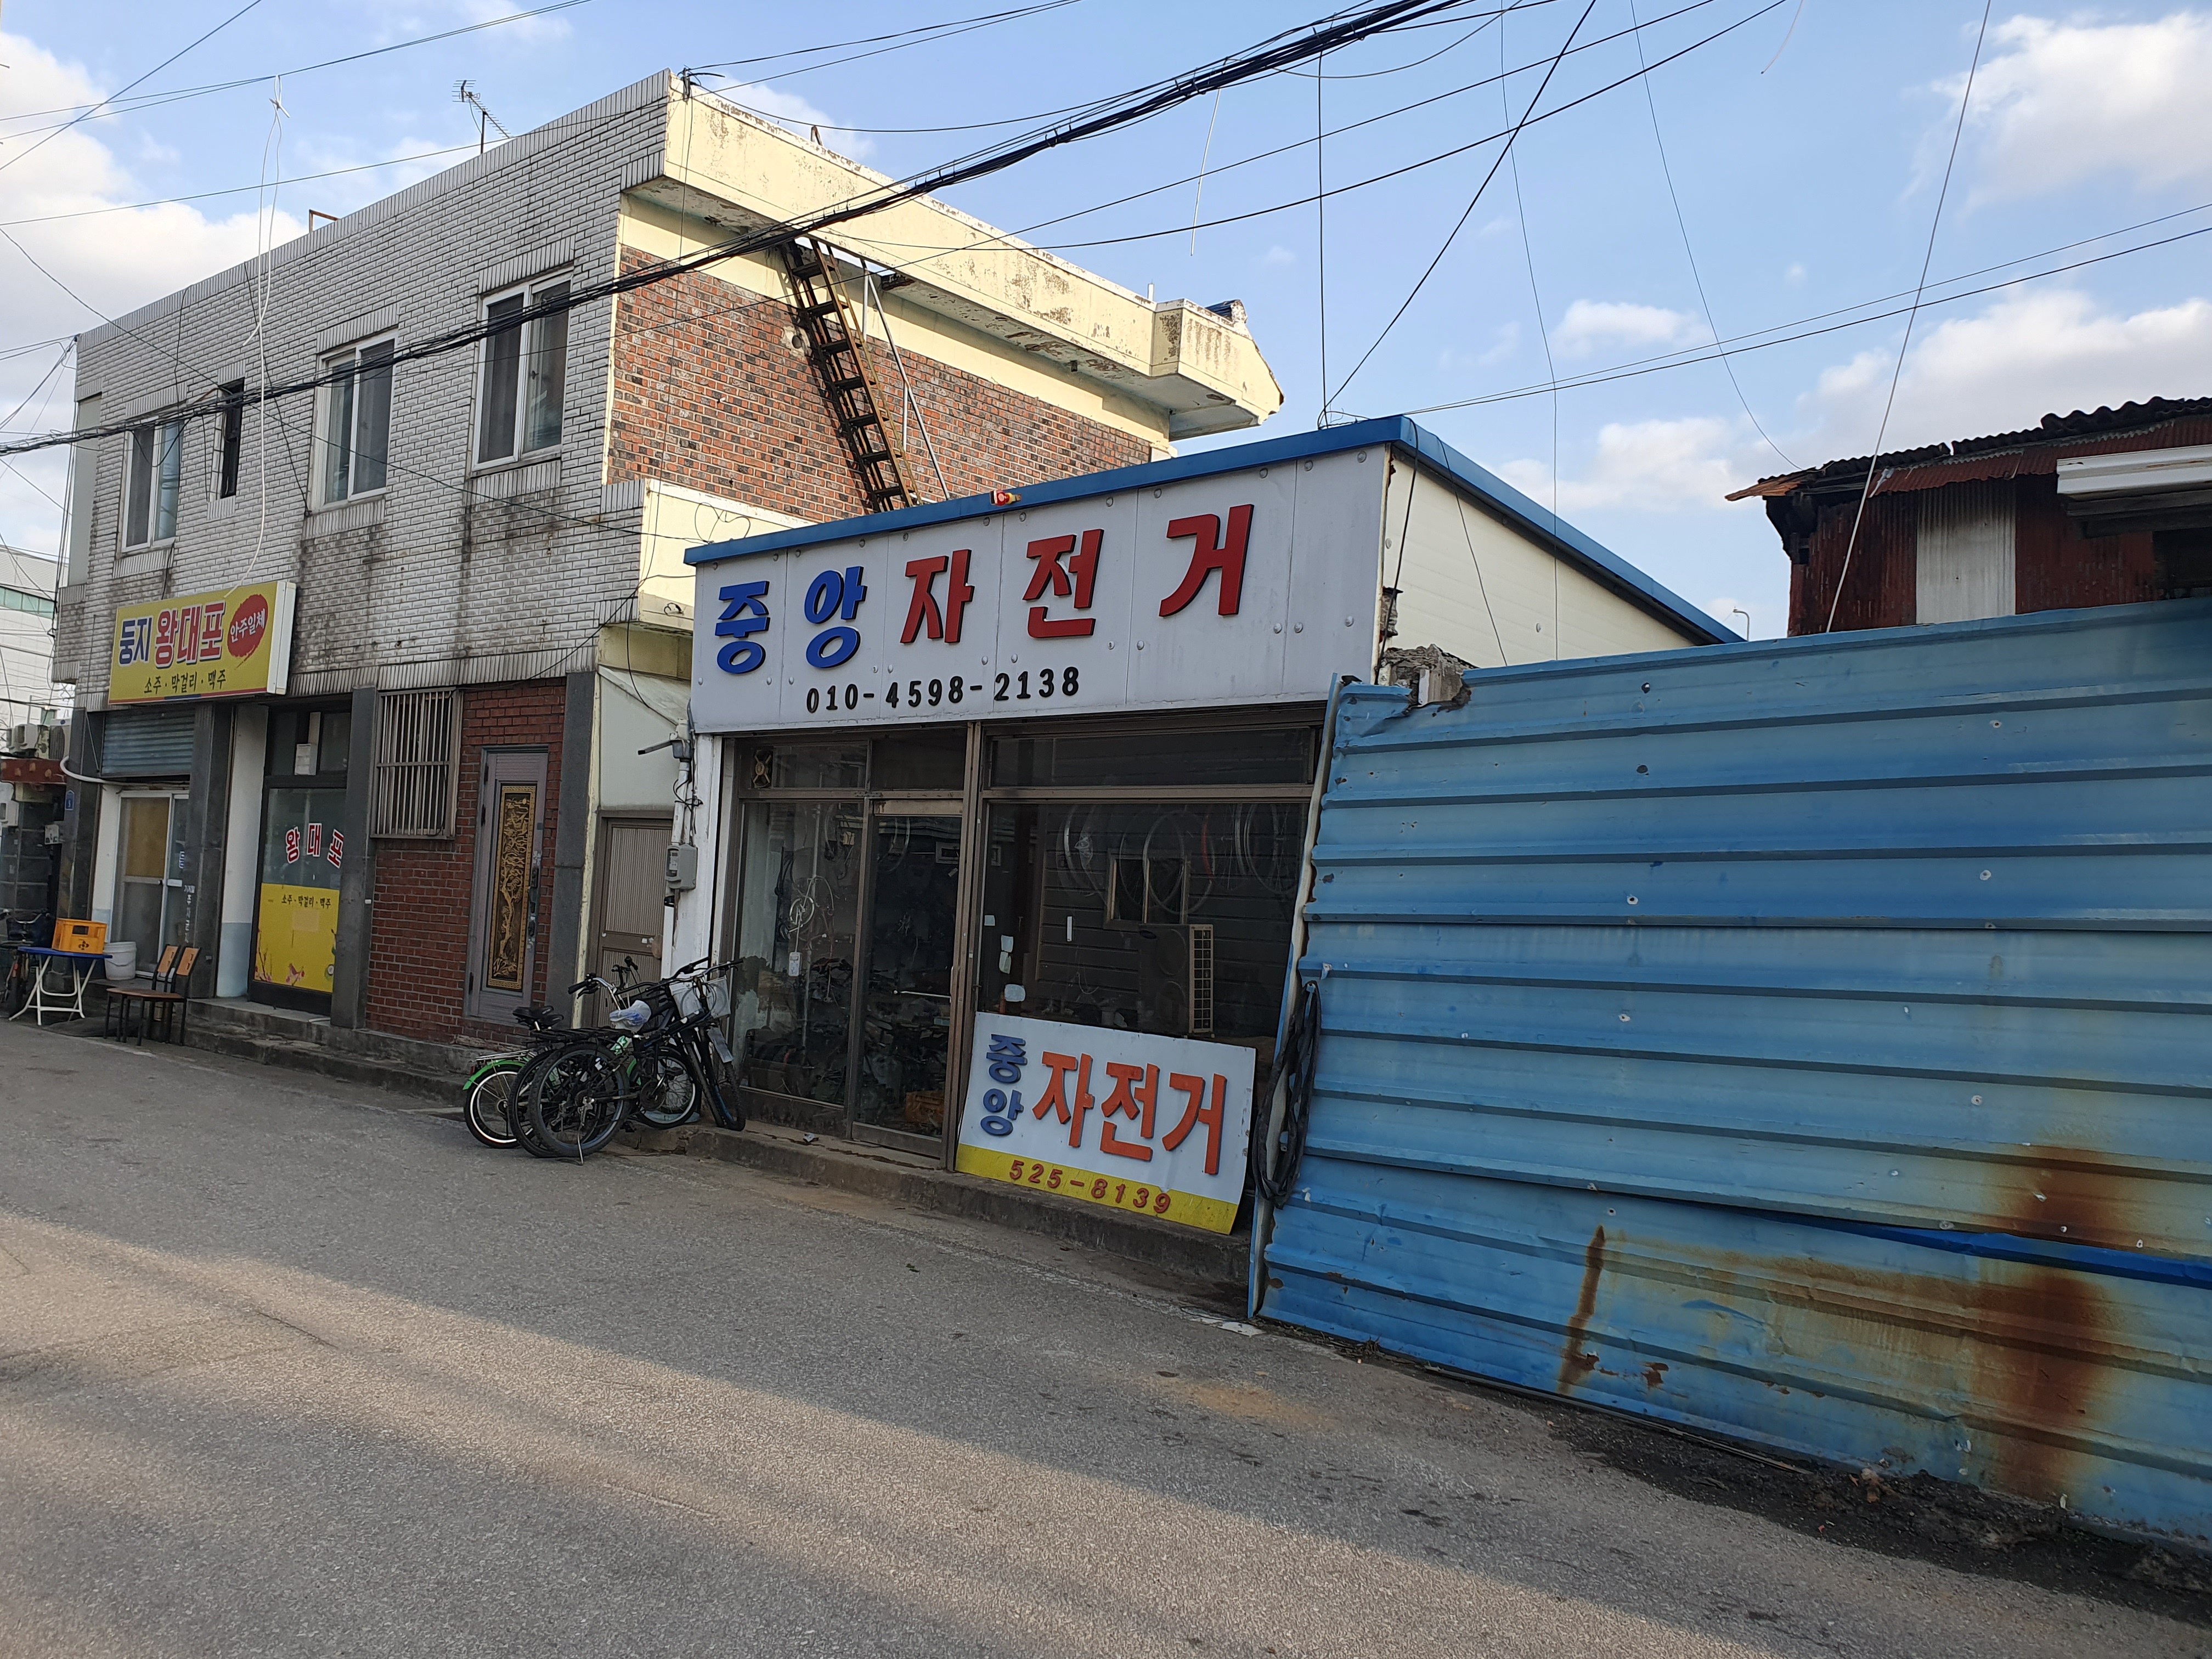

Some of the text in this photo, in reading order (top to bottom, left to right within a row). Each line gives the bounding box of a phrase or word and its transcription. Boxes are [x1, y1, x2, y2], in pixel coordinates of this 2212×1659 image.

[714, 504, 1254, 674] 중앙 자전거
[119, 601, 225, 667] 둥지 왕대포
[230, 607, 266, 643] 안주일체
[144, 669, 227, 695] 소주 막걸리 맥주
[806, 665, 1080, 714] 010-4598-2138
[285, 822, 344, 869] 왕대포
[281, 894, 292, 905] 소주
[298, 895, 314, 908] 막걸리
[980, 1034, 1228, 1175] 중앙 자전거
[1009, 1159, 1171, 1214] 525-8139
